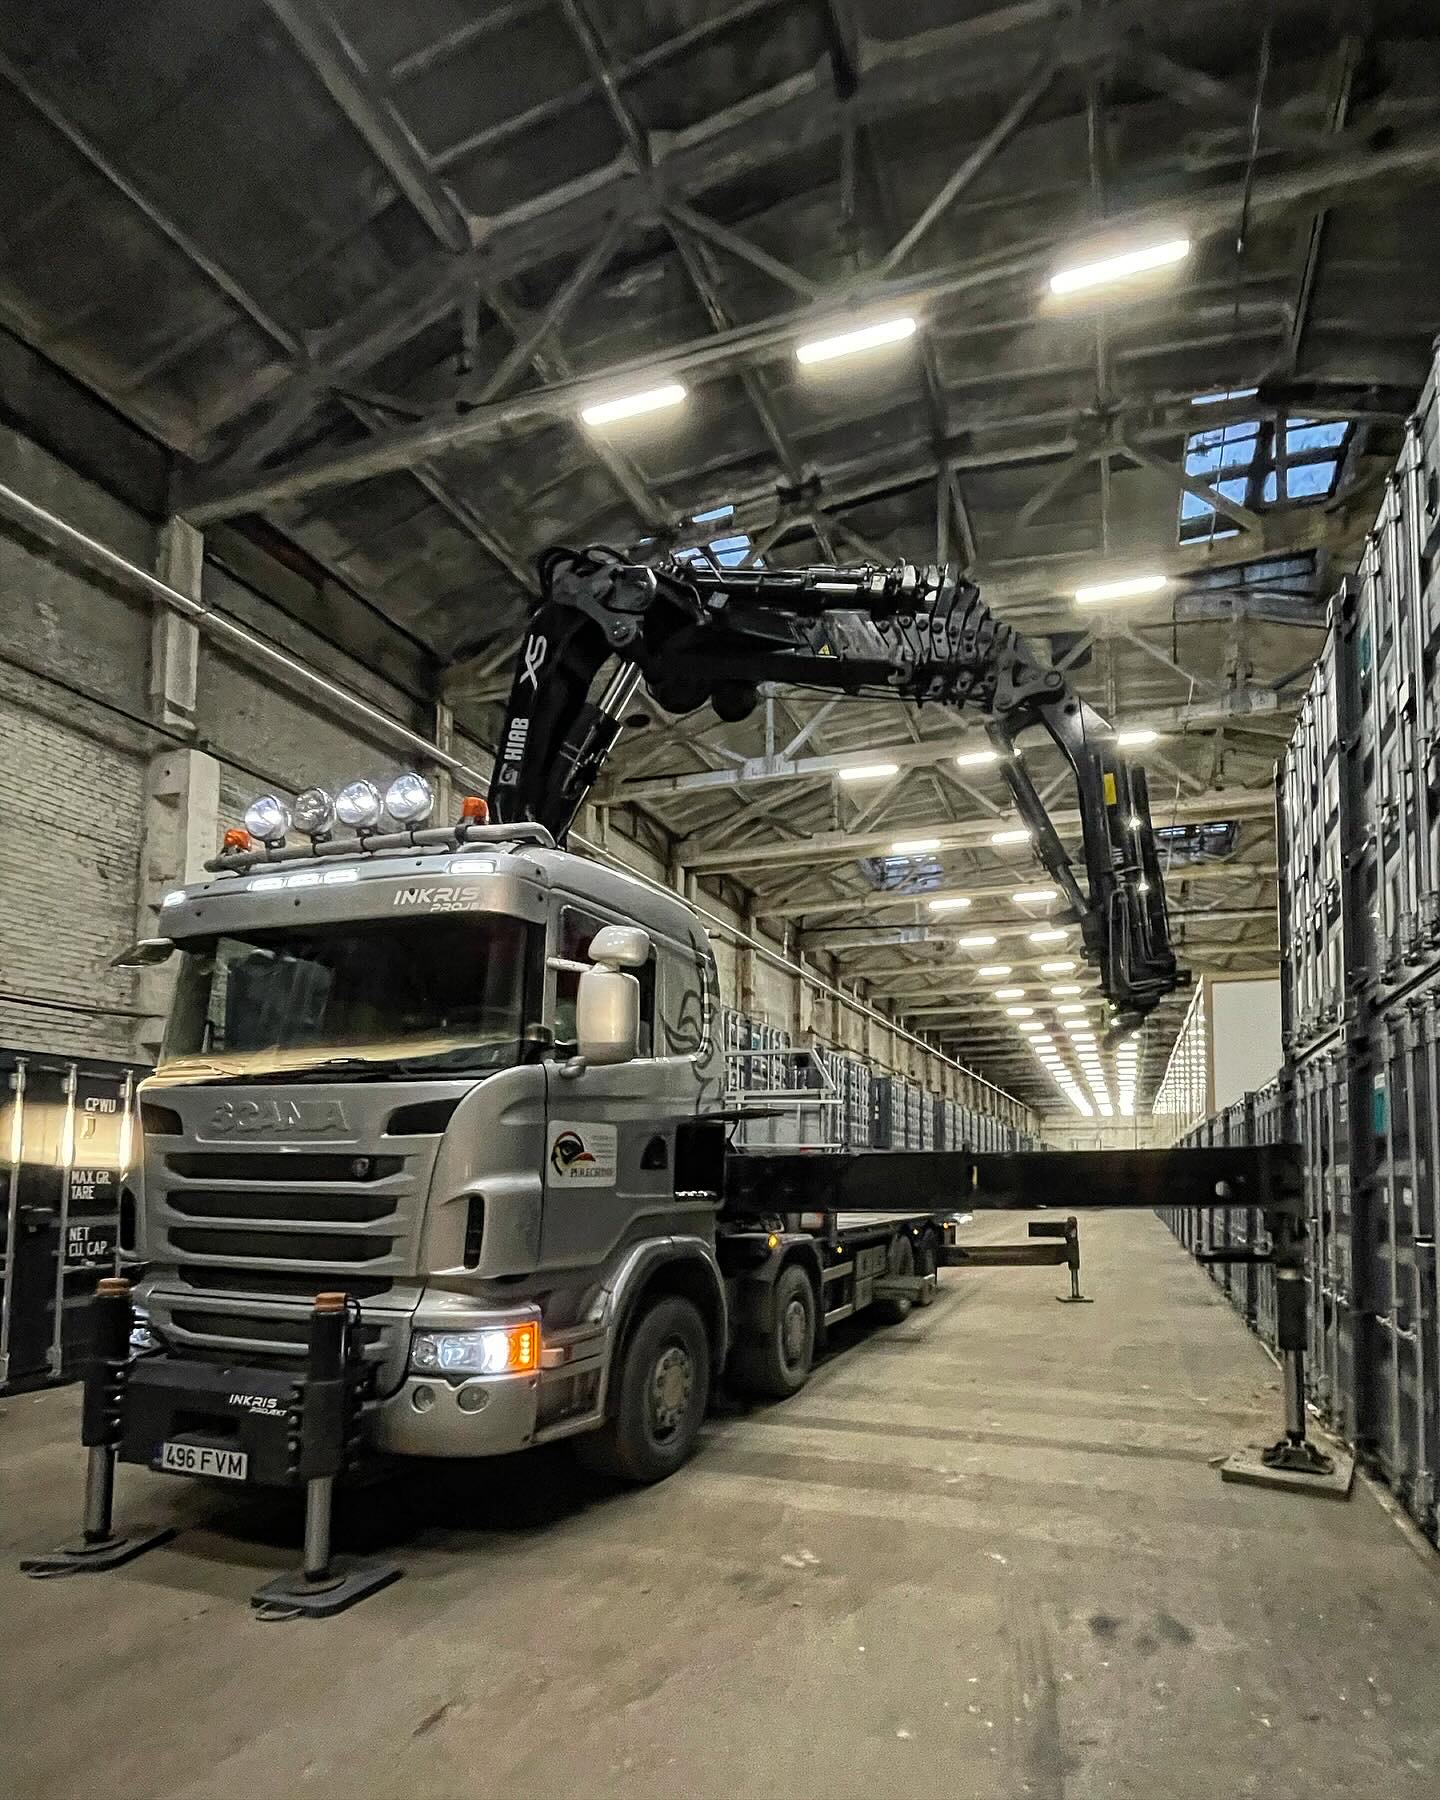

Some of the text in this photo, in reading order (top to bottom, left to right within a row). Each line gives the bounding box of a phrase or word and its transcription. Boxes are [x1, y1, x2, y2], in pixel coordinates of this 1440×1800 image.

[504, 718, 529, 760] HIAB
[393, 887, 480, 904] INKRIS
[85, 1097, 116, 1113] CPWU
[71, 1185, 95, 1199] TARE
[69, 1227, 90, 1241] NET
[229, 1394, 278, 1409] INKRIS
[167, 1446, 242, 1476] 496 FVM
